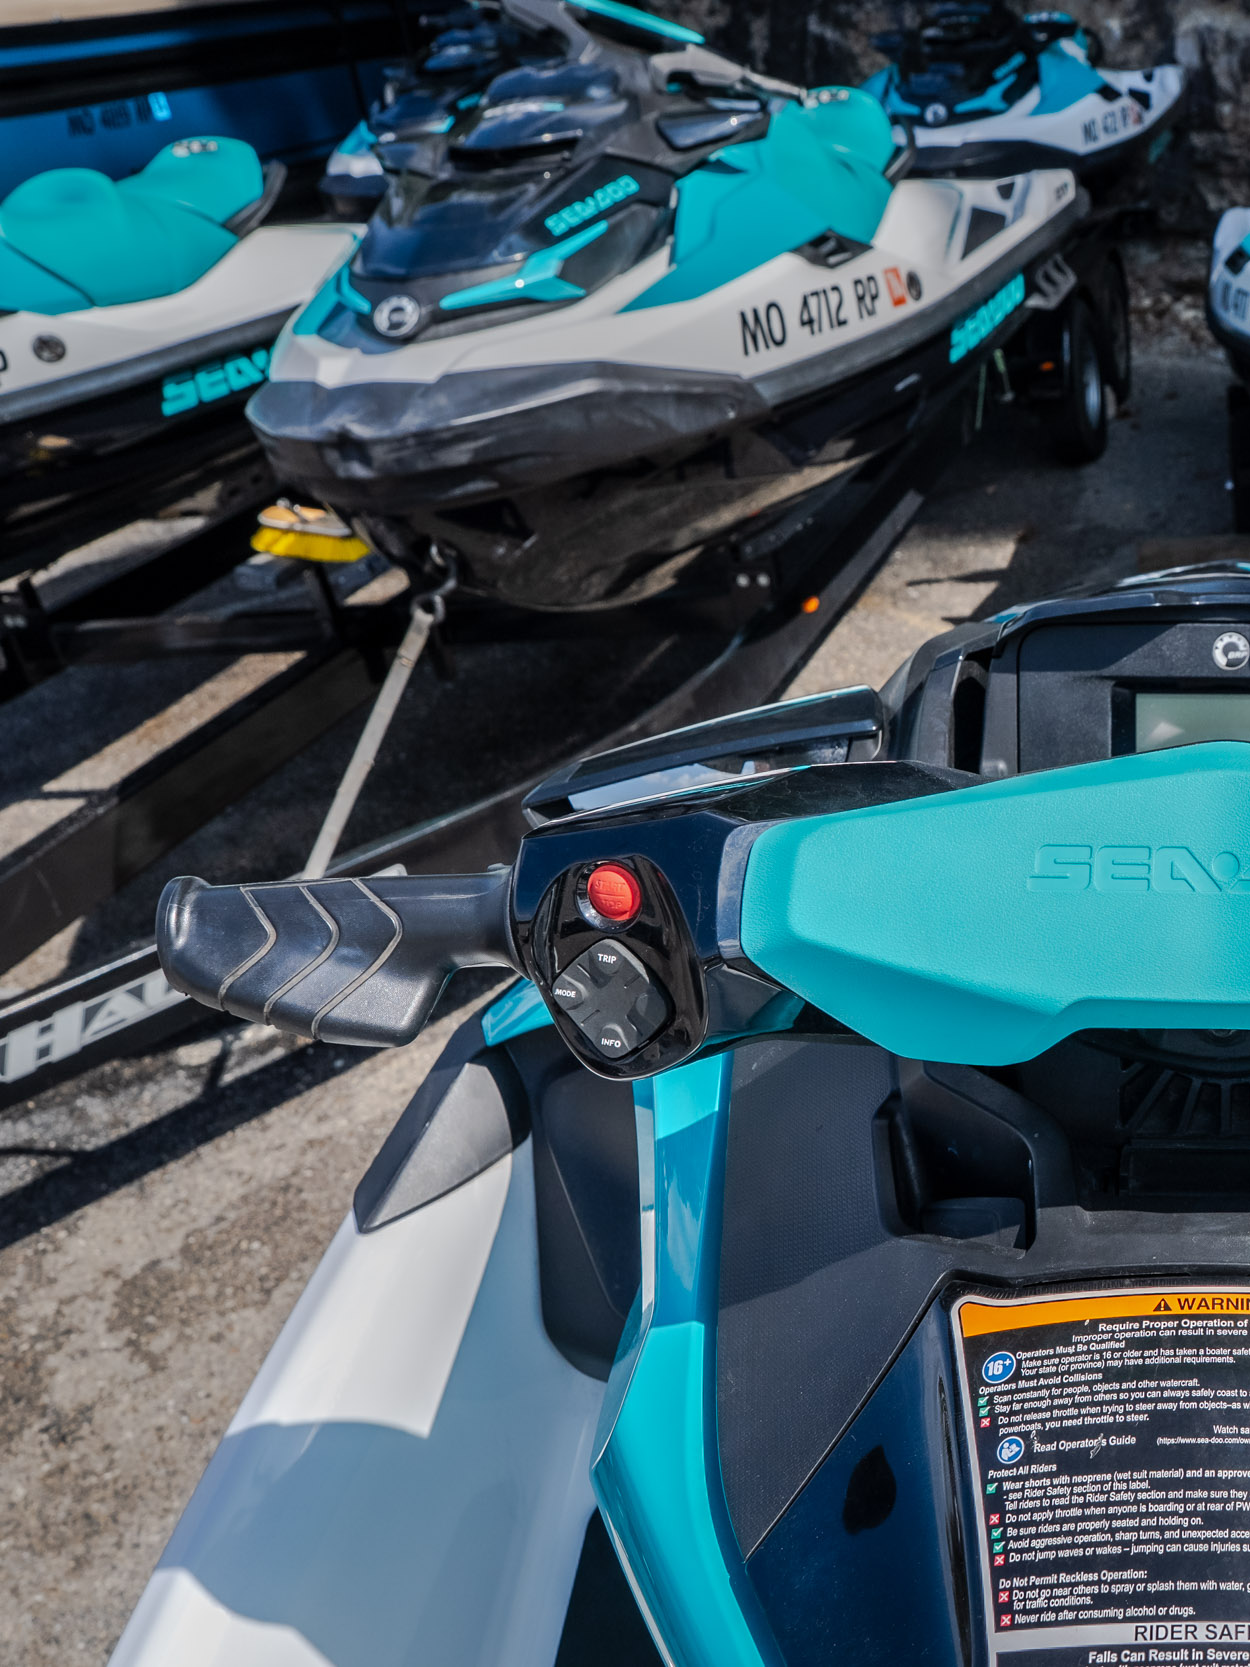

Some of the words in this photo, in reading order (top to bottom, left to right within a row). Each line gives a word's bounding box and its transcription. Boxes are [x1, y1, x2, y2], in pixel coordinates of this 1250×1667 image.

[740, 302, 786, 356] MO
[800, 285, 848, 336] 4712
[853, 275, 879, 320] RP
[597, 953, 617, 964] TRIP
[554, 988, 576, 998] MODE
[601, 1038, 622, 1048] INFO
[1098, 1320, 1139, 1334] Require
[1142, 1319, 1178, 1331] Proper
[1181, 1318, 1234, 1329] Operation
[1236, 1319, 1248, 1328] of
[1072, 1331, 1112, 1344] Improper
[1114, 1329, 1156, 1340] operation
[1178, 1328, 1203, 1336] result
[1014, 1347, 1054, 1361] Operators
[1056, 1345, 1075, 1355] Must
[1077, 1344, 1087, 1353] Be
[1089, 1340, 1125, 1353] Qualified
[978, 1382, 1016, 1396] Operators
[1017, 1380, 1037, 1390] Must
[1038, 1377, 1061, 1388] Avoid
[1062, 1372, 1102, 1385] Collisions
[993, 1394, 1011, 1404] Scan
[1013, 1390, 1049, 1404] constantly
[1051, 1388, 1061, 1398] for
[1063, 1385, 1090, 1398] people,
[1092, 1382, 1120, 1394] objects
[1121, 1380, 1136, 1390] and
[1137, 1379, 1158, 1389] other
[1159, 1378, 1200, 1387] watercraft.
[1213, 1425, 1238, 1434] Watch
[1033, 1440, 1056, 1451] Read
[1109, 1435, 1136, 1445] Guide
[987, 1468, 1017, 1479] Protect
[1017, 1466, 1029, 1476] All
[1029, 1463, 1057, 1474] Riders
[1003, 1480, 1023, 1491] Wear
[1025, 1477, 1050, 1488] shorts
[1053, 1476, 1070, 1486] with
[1072, 1474, 1111, 1486] neoprene
[1114, 1471, 1130, 1482] (wet
[1133, 1470, 1147, 1480] suit
[1149, 1469, 1184, 1481] material)
[1186, 1469, 1202, 1478] and
[1006, 1527, 1017, 1537] Be
[1019, 1527, 1036, 1536] sure
[1038, 1523, 1060, 1534] riders
[1062, 1524, 1075, 1532] are
[1077, 1519, 1110, 1532] properly
[1111, 1518, 1139, 1528] seated
[1141, 1517, 1157, 1526] and
[1158, 1516, 1189, 1527] holding
[1008, 1539, 1029, 1550] Avoid
[1031, 1535, 1072, 1549] aggressive
[1074, 1532, 1112, 1546] operation,
[1115, 1531, 1137, 1543] sharp
[1140, 1530, 1162, 1542] turns,
[1164, 1530, 1179, 1539] and
[1182, 1529, 1228, 1540] unexpected
[999, 1578, 1011, 1589] Do
[1012, 1577, 1028, 1588] Not
[1029, 1575, 1057, 1587] Permit
[1059, 1573, 1098, 1585] Reckless
[1100, 1569, 1147, 1584] Operation:
[1013, 1590, 1024, 1600] Do
[1026, 1589, 1038, 1599] not
[1040, 1589, 1050, 1600] go
[1053, 1588, 1071, 1597] near
[1073, 1584, 1098, 1595] others
[1101, 1584, 1109, 1593] to
[1111, 1584, 1134, 1595] spray
[1147, 1581, 1174, 1593] splash
[1177, 1581, 1198, 1590] them
[1200, 1581, 1217, 1590] with
[1219, 1581, 1244, 1592] water,
[1013, 1600, 1024, 1610] for
[1025, 1599, 1048, 1610] traffic
[1049, 1596, 1093, 1608] conditions.
[1014, 1613, 1038, 1624] Never
[1040, 1612, 1056, 1622] ride
[1057, 1611, 1076, 1621] after
[1078, 1608, 1124, 1622] consuming
[1125, 1607, 1156, 1617] alcohol
[1168, 1605, 1196, 1617] drugs.
[1135, 1625, 1198, 1641] RIDER
[1089, 1651, 1117, 1664] Falls
[1121, 1650, 1145, 1662] Can
[1149, 1649, 1188, 1662] Result
[1192, 1649, 1203, 1660] in
[1207, 1648, 1249, 1660] Severe
